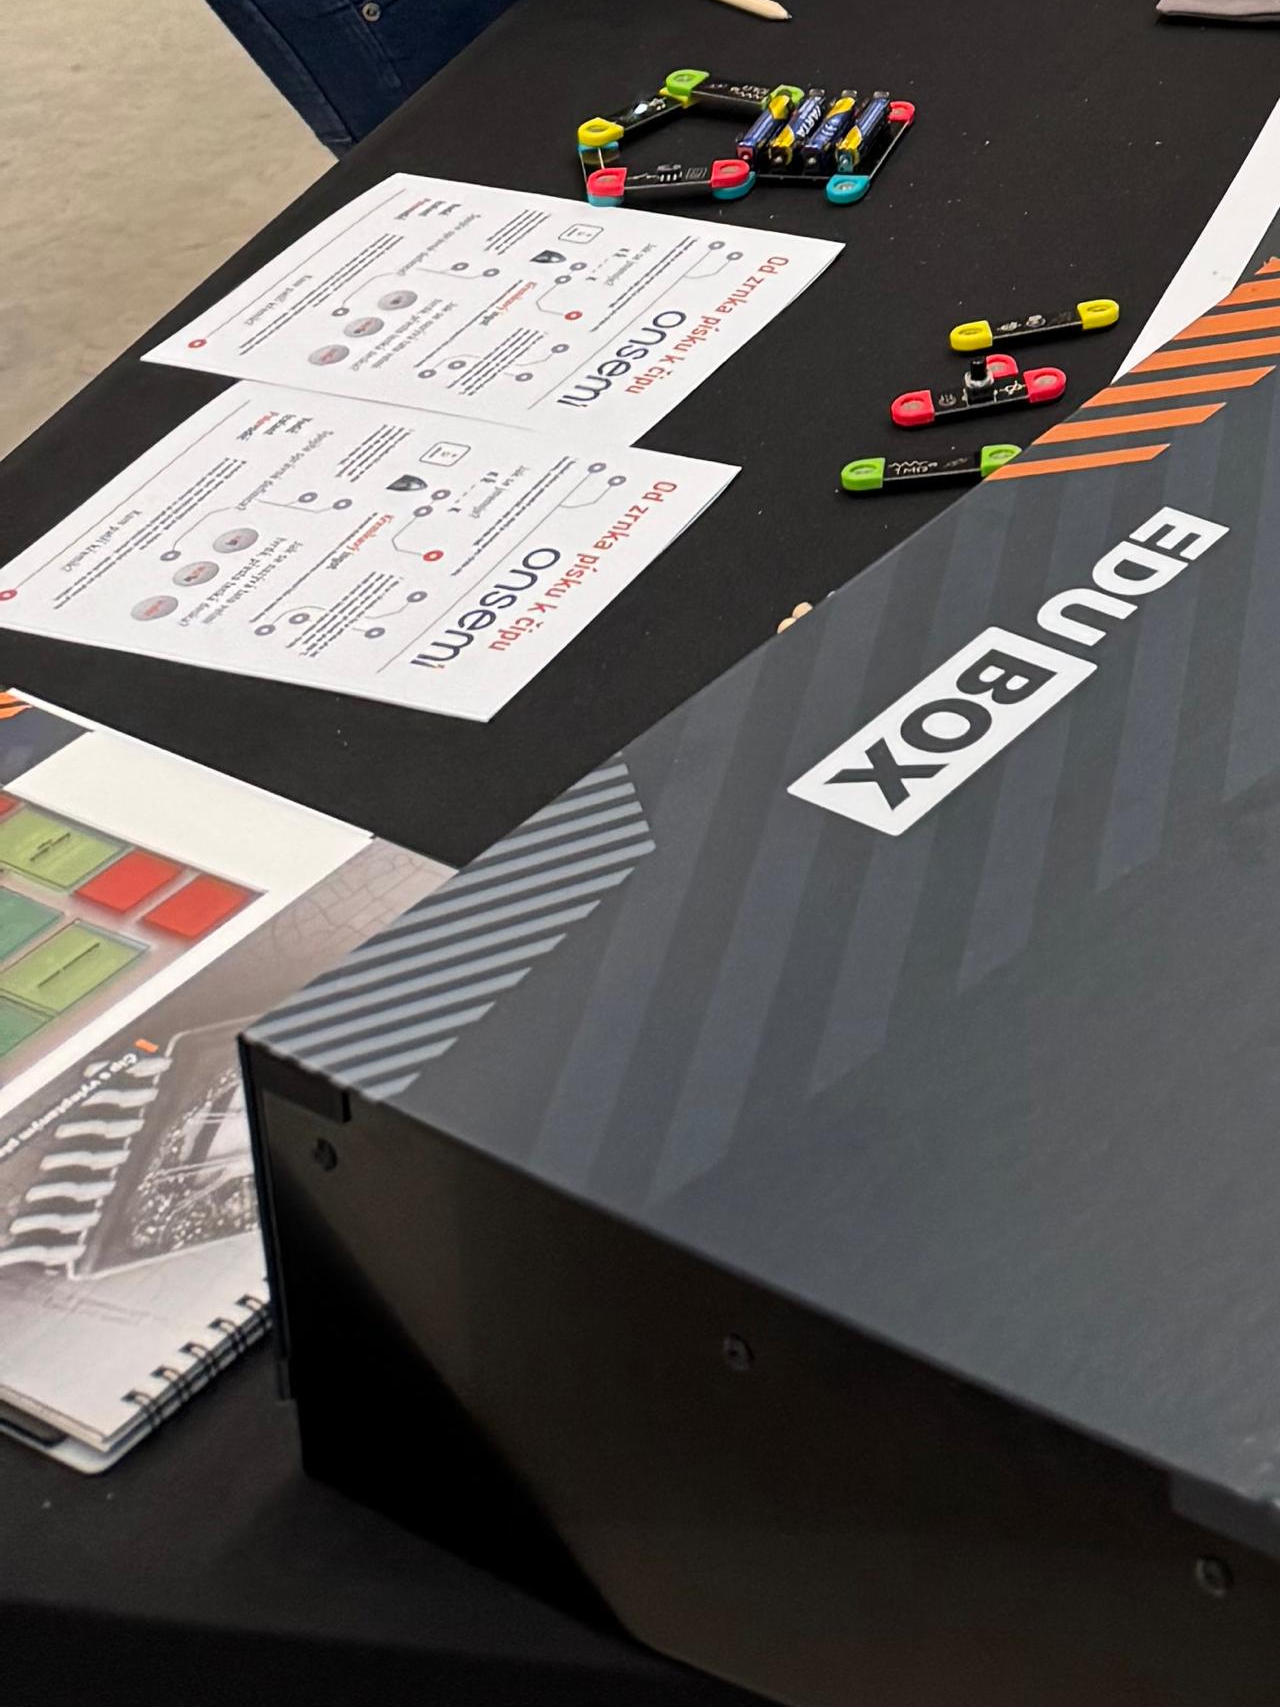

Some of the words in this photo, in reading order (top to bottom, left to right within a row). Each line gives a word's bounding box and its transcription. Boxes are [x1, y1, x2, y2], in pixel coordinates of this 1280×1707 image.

[758, 257, 789, 274] Od
[715, 276, 764, 313] zrnka
[673, 316, 721, 352] písku
[557, 311, 686, 407] onsemi
[659, 355, 685, 363] k
[625, 367, 672, 394] čipu
[642, 482, 677, 502] Od
[593, 505, 648, 550] zrnka
[544, 553, 600, 598] písku
[1036, 506, 1230, 647] EDU
[410, 548, 560, 668] onsemi
[528, 602, 557, 613] k
[488, 617, 544, 651] čipu
[824, 648, 1056, 811] BOX
